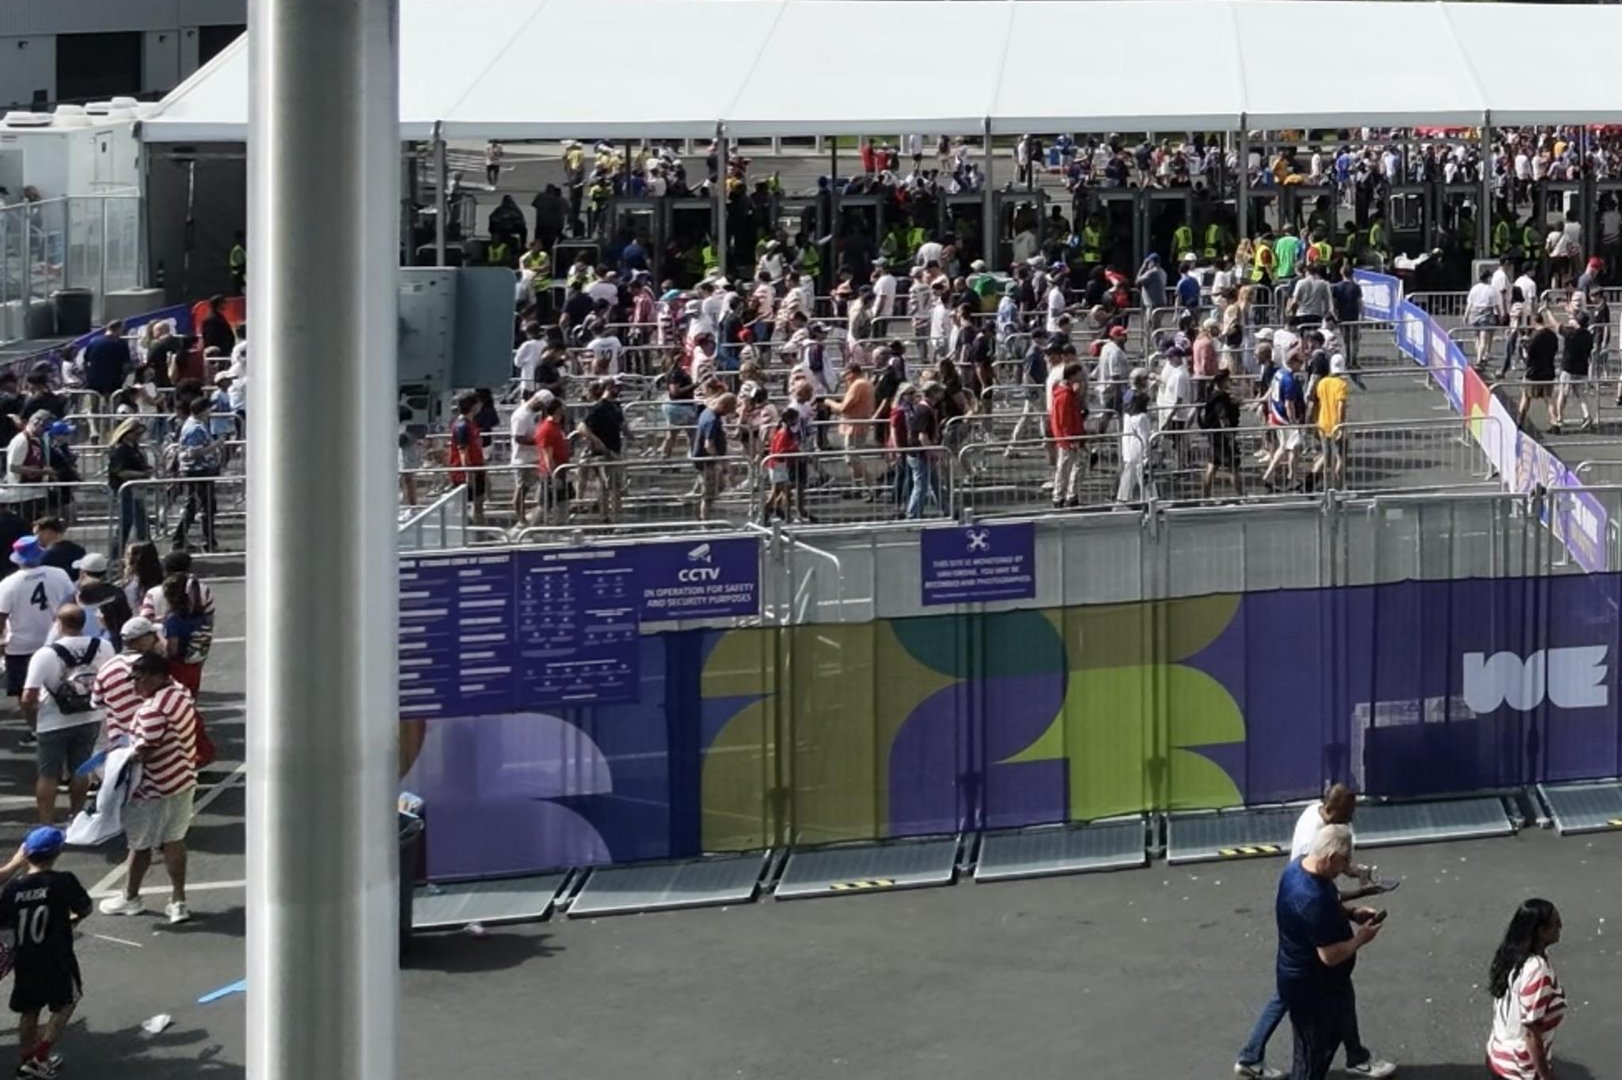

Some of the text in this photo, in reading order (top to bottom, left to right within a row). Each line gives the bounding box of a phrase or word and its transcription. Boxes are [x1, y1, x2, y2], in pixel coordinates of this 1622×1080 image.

[678, 567, 720, 582] CCTV
[30, 581, 48, 610] 4
[647, 593, 752, 608] AND SECURITY PURPOSES
[656, 586, 705, 597] OPERATION
[706, 585, 724, 594] FOR
[724, 583, 754, 593] SAFETY
[1463, 645, 1608, 714] WE
[18, 905, 49, 947] 10
